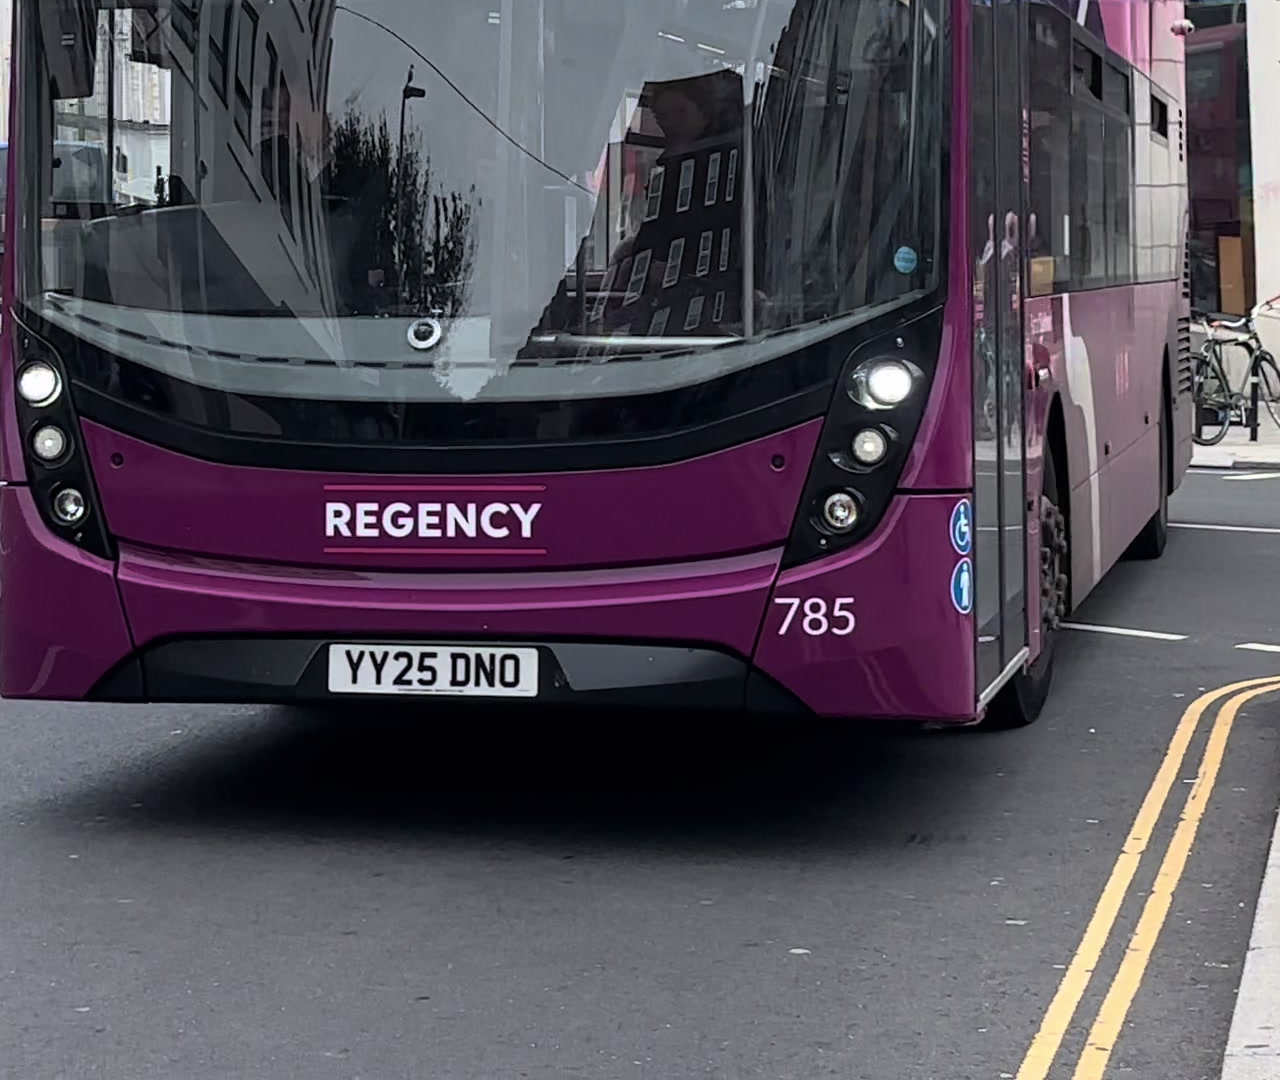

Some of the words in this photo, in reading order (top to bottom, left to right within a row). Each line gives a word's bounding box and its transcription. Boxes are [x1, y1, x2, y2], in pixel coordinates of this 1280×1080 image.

[325, 502, 542, 538] REGENCY
[774, 597, 856, 636] 785
[345, 650, 438, 686] YY25
[450, 652, 520, 688] DNO
